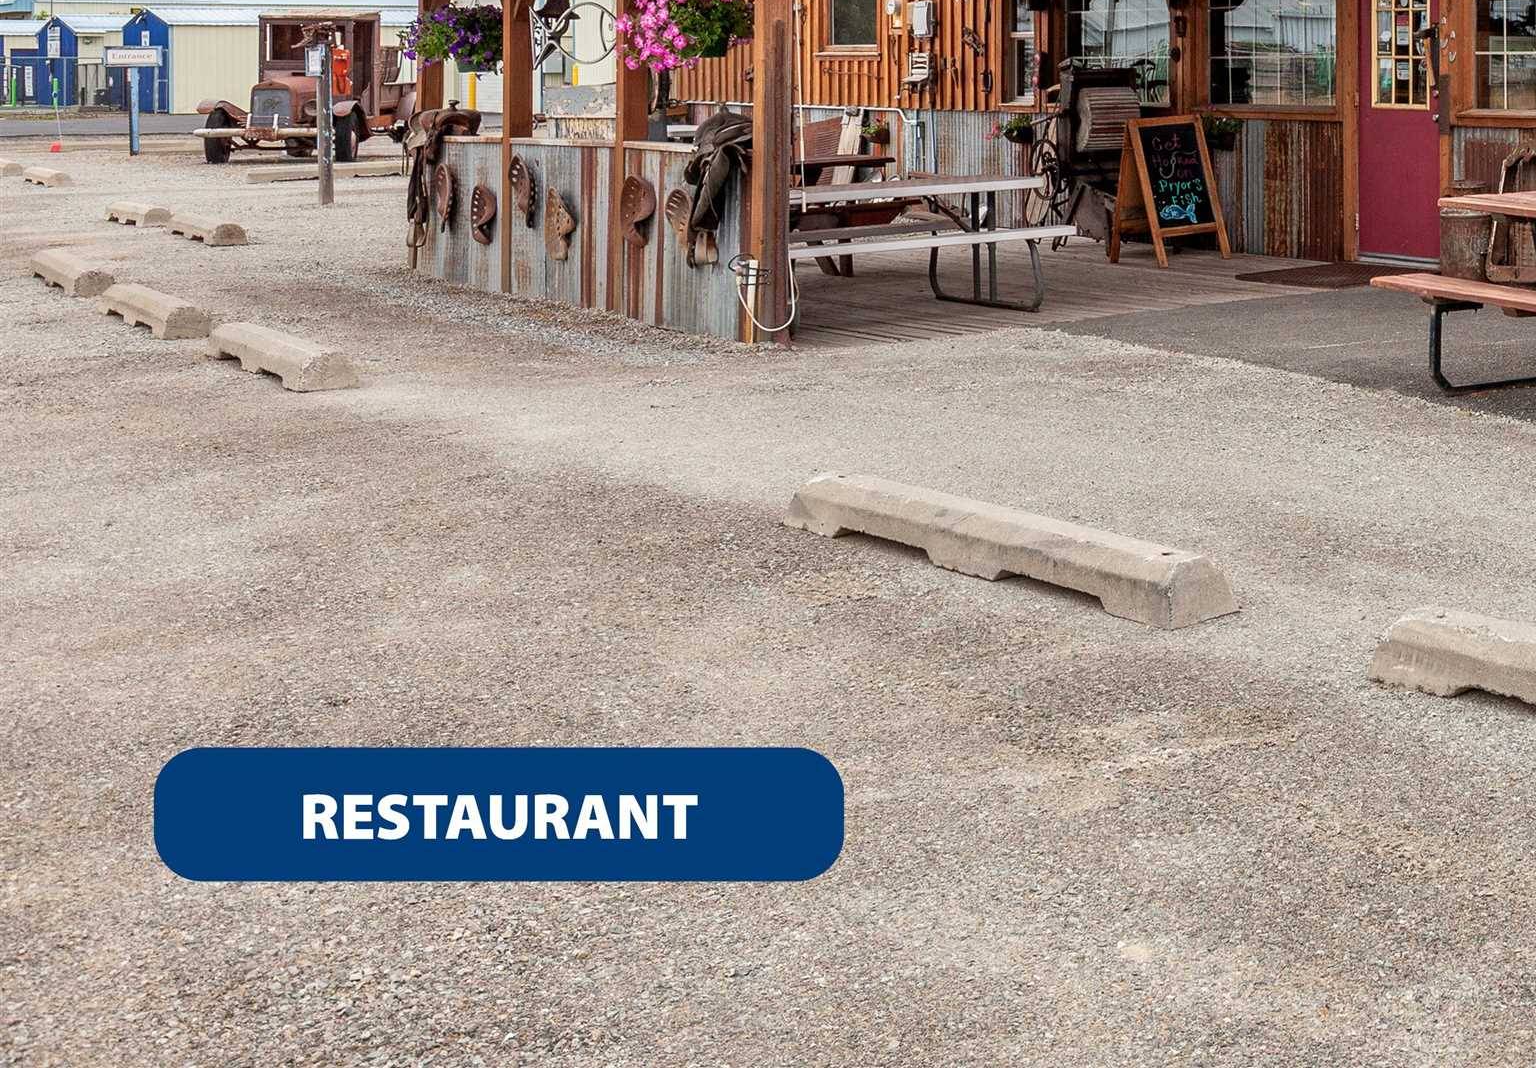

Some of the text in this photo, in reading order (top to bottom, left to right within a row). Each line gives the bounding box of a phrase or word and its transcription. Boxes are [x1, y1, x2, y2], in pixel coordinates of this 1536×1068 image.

[111, 52, 154, 60] Entrance
[1151, 133, 1182, 151] Get
[1158, 178, 1203, 196] Pryor's
[1171, 192, 1200, 205] Fish
